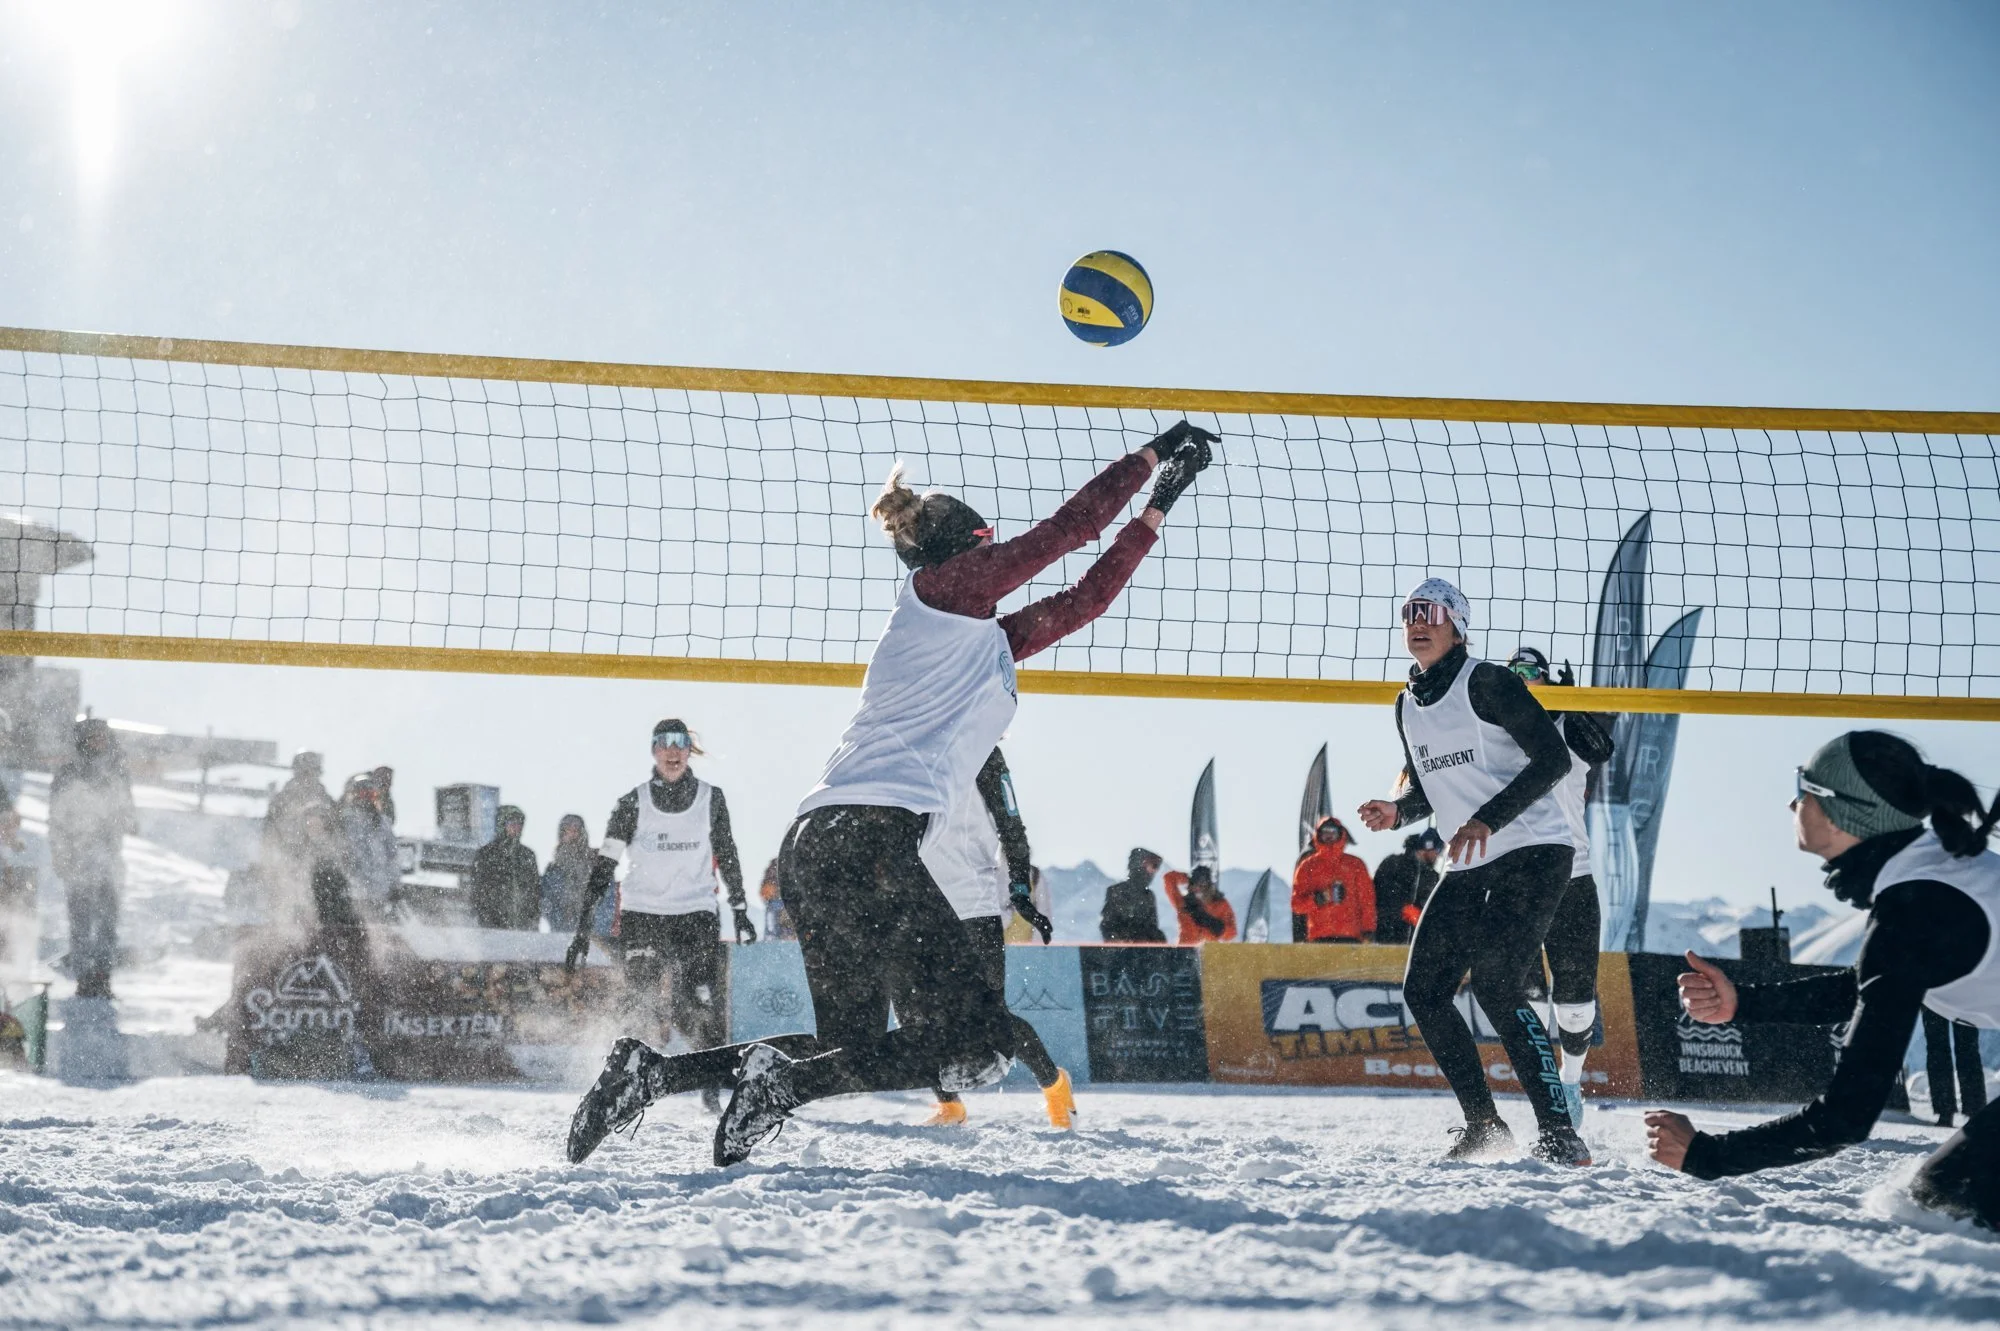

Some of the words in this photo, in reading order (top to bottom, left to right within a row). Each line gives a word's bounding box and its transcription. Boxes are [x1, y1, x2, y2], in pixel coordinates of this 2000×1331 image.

[1418, 744, 1429, 758] MY
[1422, 749, 1475, 773] BEACHEVENT
[1681, 1041, 1744, 1059] INNSBRUCK
[1679, 1058, 1749, 1077] BEACHEVENT
